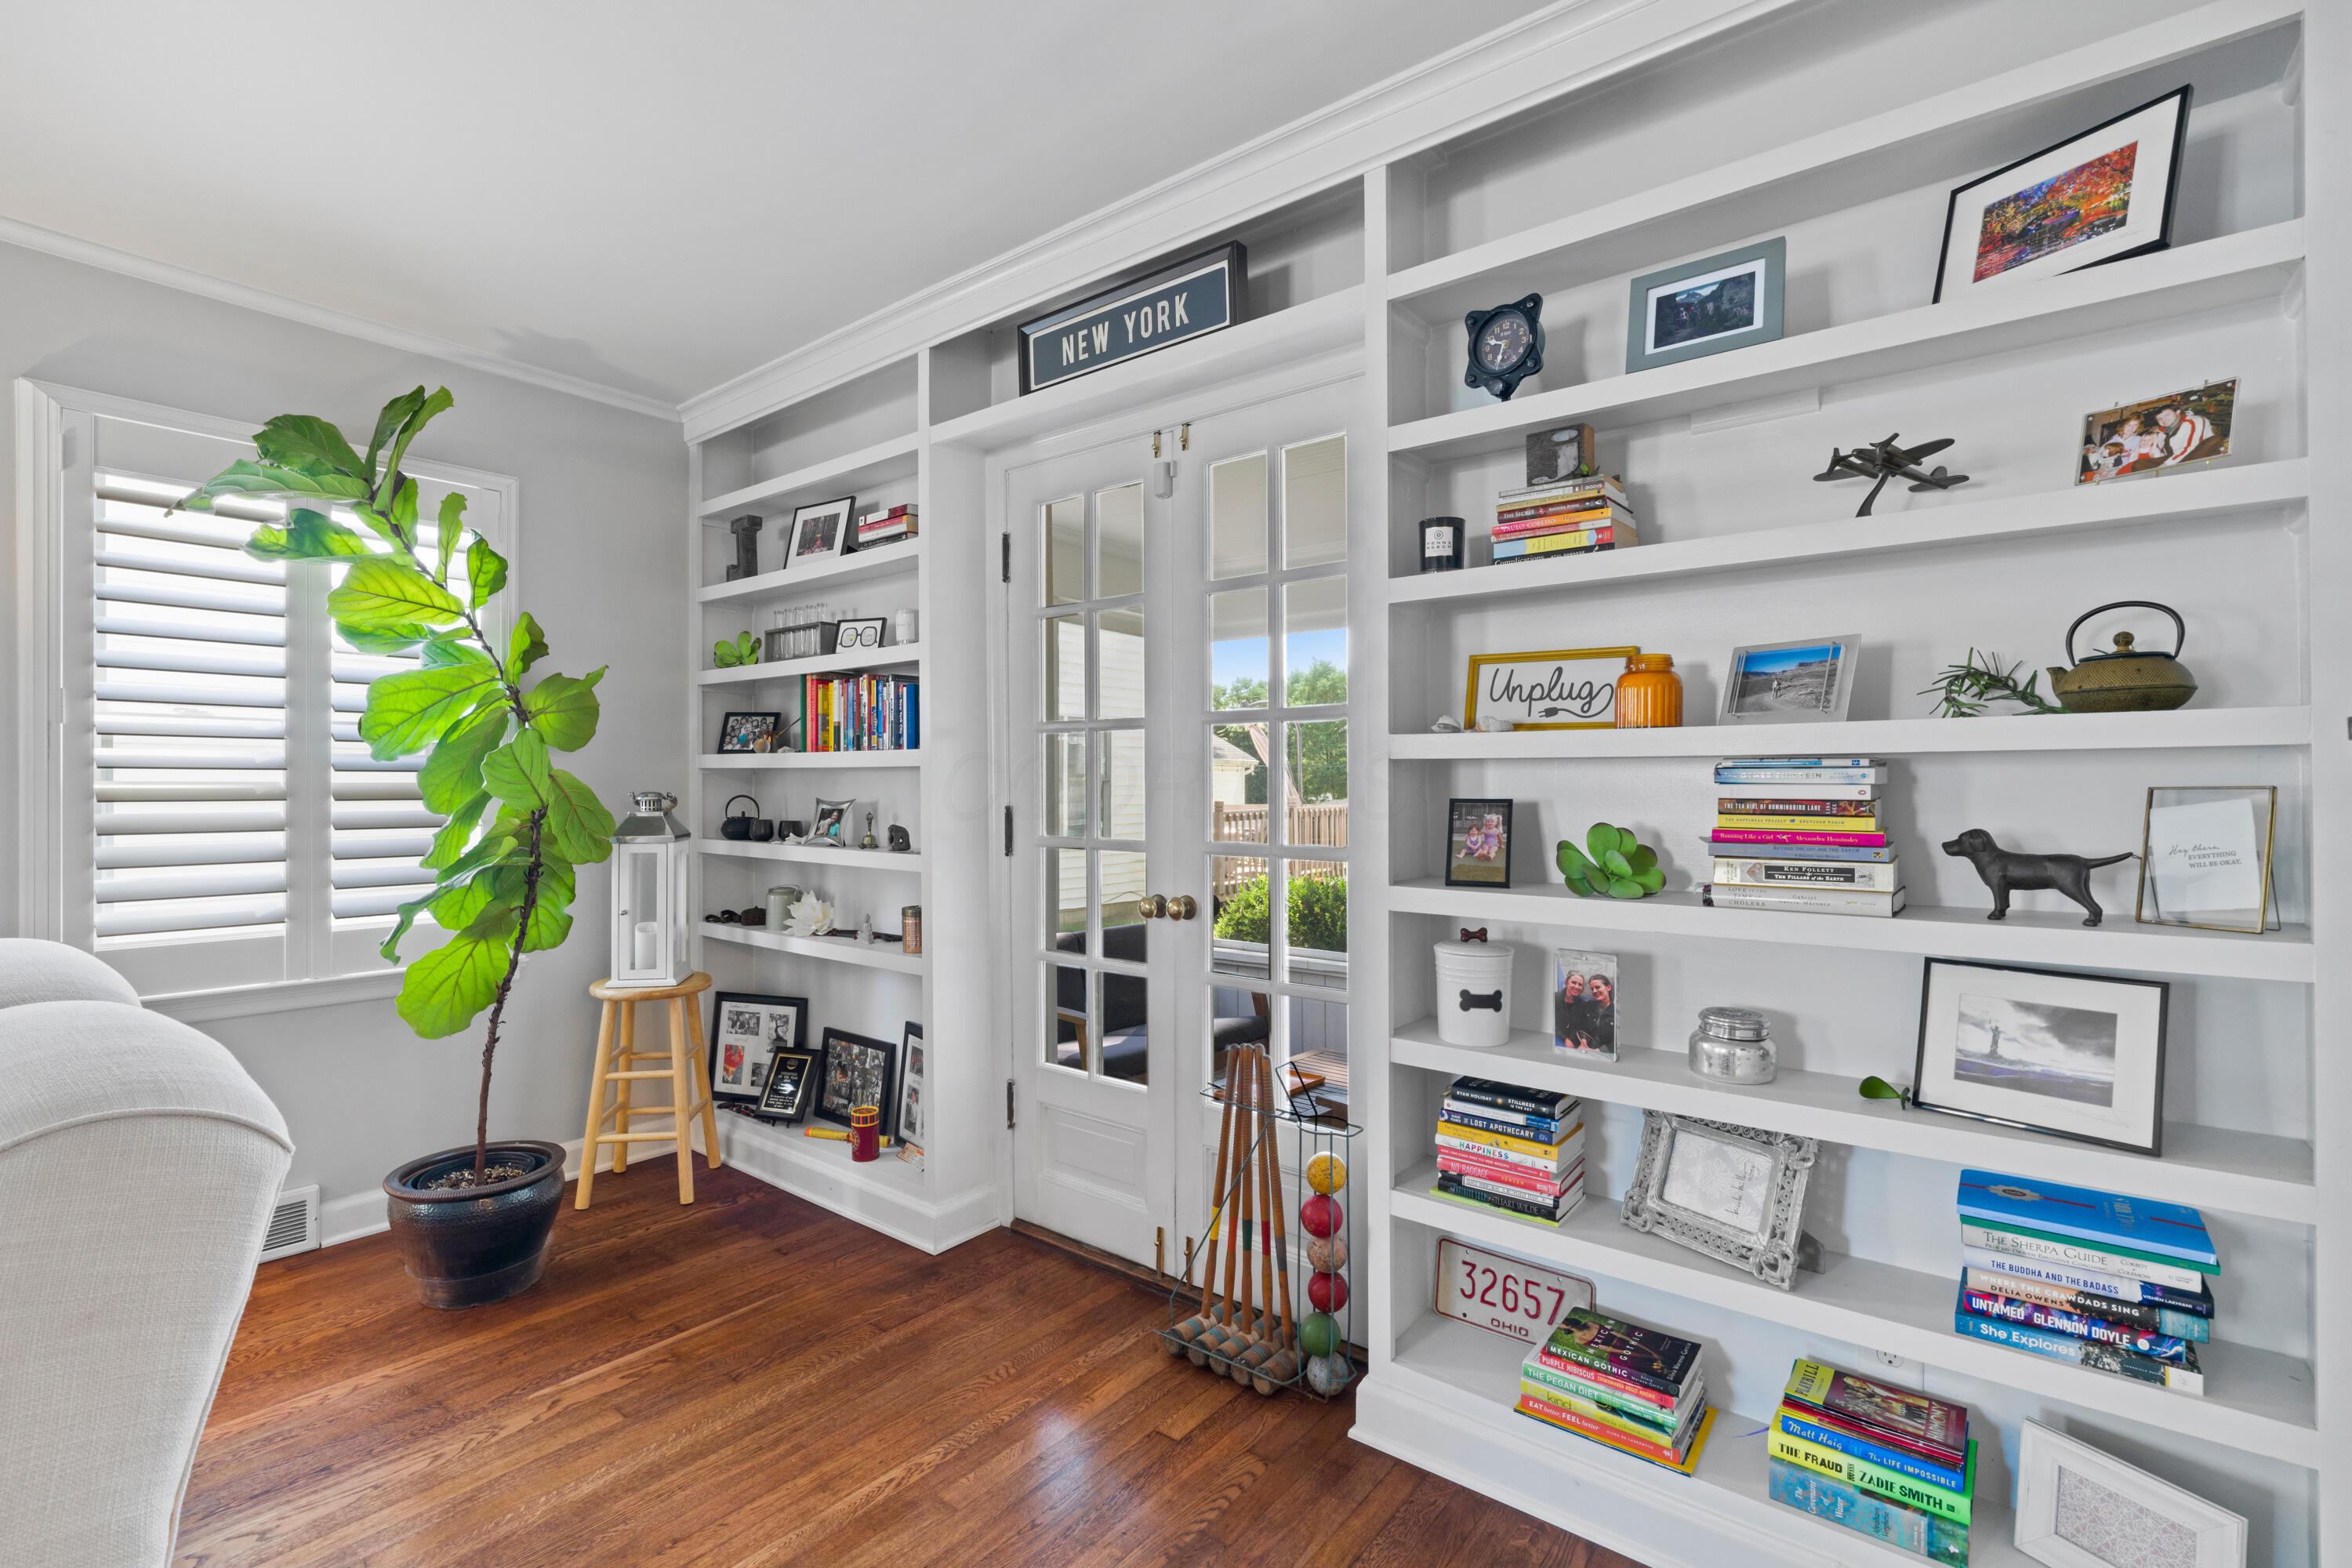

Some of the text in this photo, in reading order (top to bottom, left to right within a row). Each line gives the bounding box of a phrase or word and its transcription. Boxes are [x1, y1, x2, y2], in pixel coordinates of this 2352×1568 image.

[1062, 292, 1189, 366] NEW YORK
[1501, 524, 1525, 532] PAULO
[1526, 519, 1556, 529] COELHO
[1490, 666, 1597, 717] Unplug
[2169, 844, 2187, 858] Hey
[2188, 851, 2237, 860] EVERYTHING
[1471, 1093, 1492, 1102] HOLIDAY
[1508, 1098, 1535, 1108] STILLNESS
[1490, 1123, 1535, 1138] APOTHECARY
[1460, 1142, 1509, 1160] HAPPINESS
[1450, 1162, 1489, 1179] NO BAGGAGE
[1491, 1196, 1515, 1207] STUART
[1516, 1201, 1538, 1215] WILDE
[1983, 1231, 2108, 1265] THE SHERPA GUIDE
[1991, 1260, 2119, 1295] THE BUDDHA AND THE BADASS
[1460, 1259, 1565, 1326] 32657
[1980, 1273, 2140, 1317] WHERE THE CRAWDADS SING
[1991, 1284, 2065, 1308] DELIA OWENS
[2143, 1294, 2194, 1309] VISHEN LAKHIANI
[1490, 1318, 1529, 1337] OHIO
[1971, 1297, 2131, 1346] UNTAMED GLENNON DOYLE
[1587, 1319, 1616, 1355] MEXICAN
[1619, 1331, 1643, 1361] GOTHIC
[1980, 1323, 2076, 1357] She Explores
[1542, 1356, 1595, 1381] PURPLE HIBISCUS
[1549, 1345, 1628, 1377] MEXICAN GOTHIC
[1528, 1367, 1599, 1400] THE PEGAN DIET
[1598, 1375, 1624, 1389] CHIMAMANDA
[1794, 1363, 1820, 1397] PLAYBILL
[1546, 1391, 1572, 1410] kind
[1529, 1400, 1544, 1410] EAT
[1562, 1413, 1581, 1425] FEEL
[1581, 1419, 1600, 1432] better
[1926, 1400, 1948, 1443] HARMONY
[1788, 1421, 1842, 1450] Matt Haig
[1778, 1443, 1843, 1474] THE FRAUD
[1883, 1457, 1901, 1469] LIFE
[1904, 1463, 1957, 1488] IMPOSSIBLE
[1795, 1486, 1804, 1500] The
[1808, 1480, 1817, 1515] Covenant
[1820, 1496, 1831, 1507] of
[1858, 1469, 1943, 1510] ZADIE SMITH
[1835, 1496, 1844, 1518] Water
